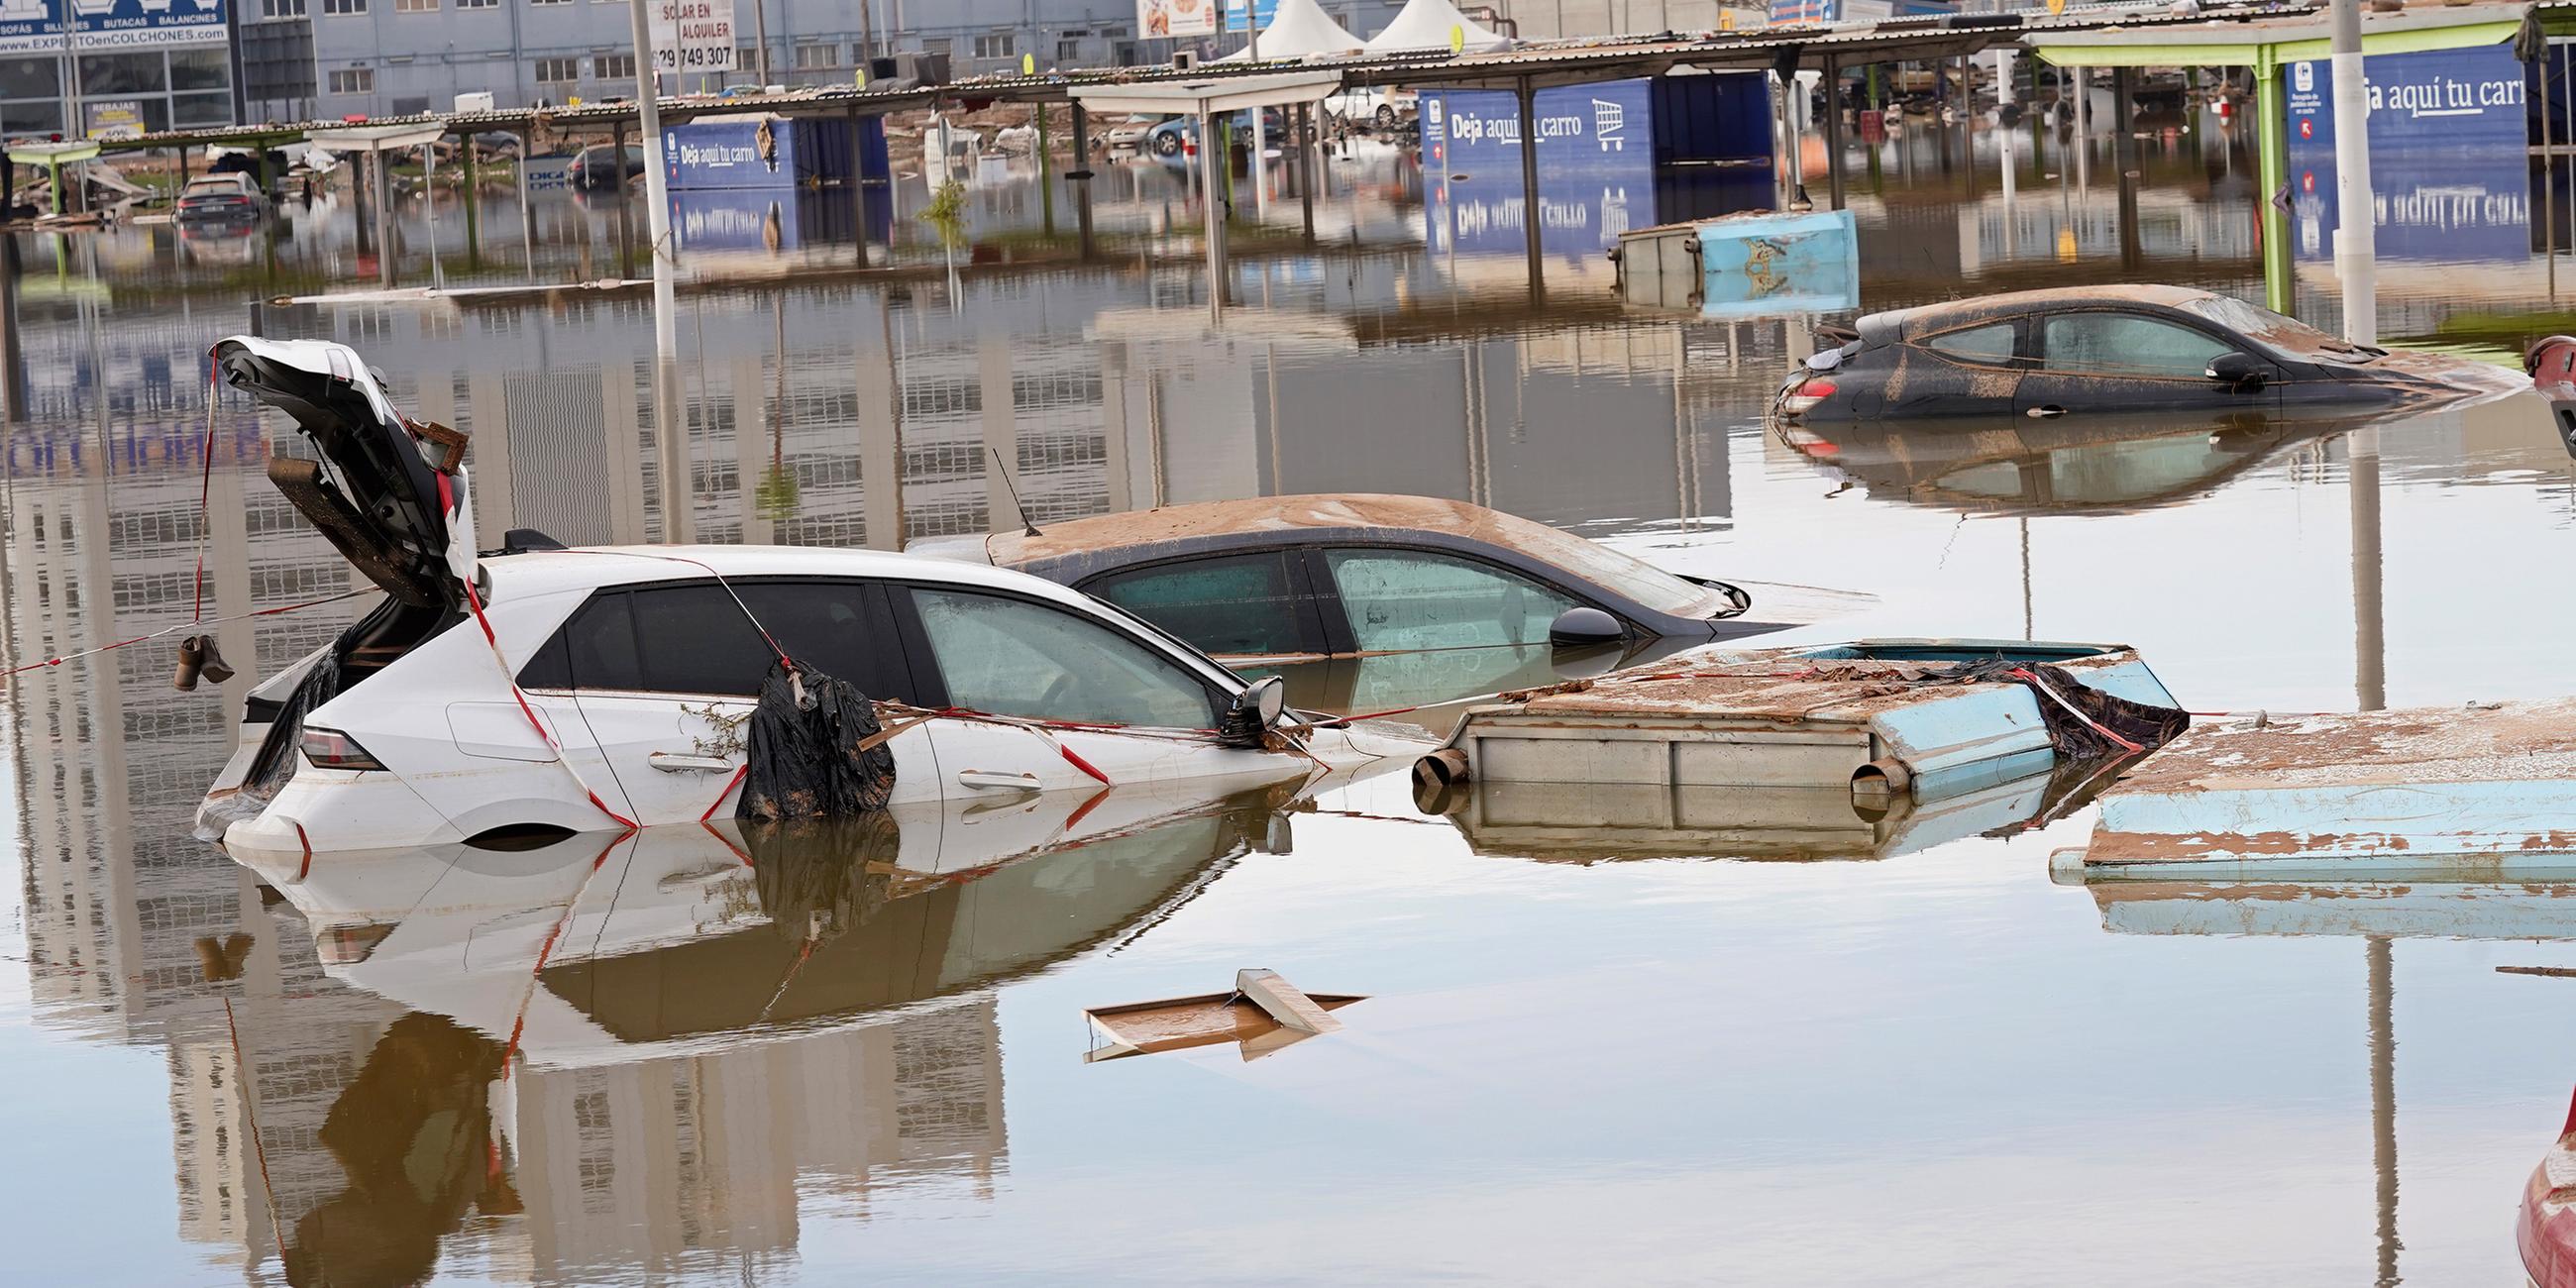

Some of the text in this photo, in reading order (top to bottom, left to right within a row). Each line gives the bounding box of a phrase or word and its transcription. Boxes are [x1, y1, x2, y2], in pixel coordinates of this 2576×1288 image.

[103, 17, 148, 29] BUTACAS
[159, 13, 217, 26] BALANCINES
[698, 4, 710, 19] EN
[682, 22, 729, 40] ALQUILER
[681, 48, 703, 66] 749
[707, 46, 731, 65] 307
[92, 101, 136, 112] REBAJAS
[2389, 75, 2442, 119] aquí
[2446, 78, 2474, 108] tu
[1451, 112, 1483, 146] Deja
[1486, 113, 1520, 145] aquí
[1541, 116, 1582, 137] carro
[681, 144, 699, 168] Deja
[700, 143, 719, 167] aquí
[719, 145, 730, 162] tu
[731, 147, 755, 163] carro
